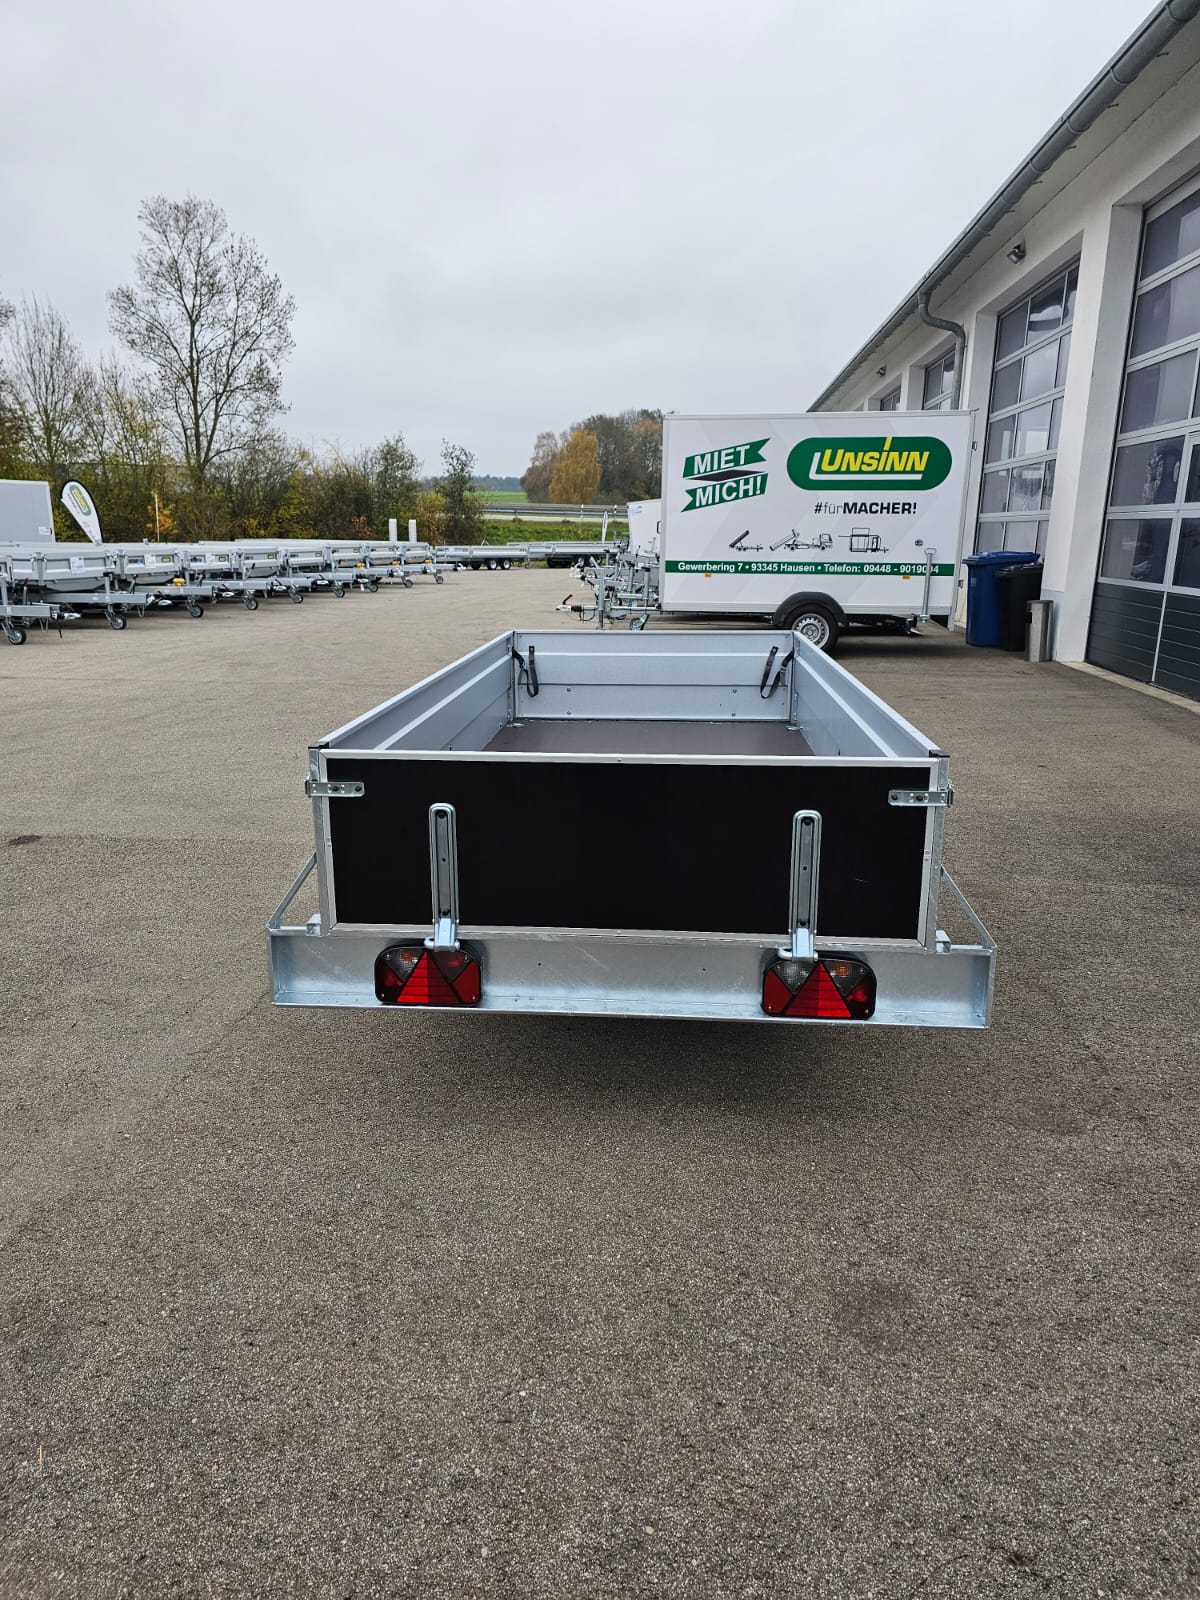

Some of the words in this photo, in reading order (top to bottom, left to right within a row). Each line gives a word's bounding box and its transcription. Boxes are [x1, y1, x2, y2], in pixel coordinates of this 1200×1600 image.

[694, 445, 750, 474] MIET
[695, 475, 762, 507] MICH!
[814, 501, 918, 515] #fürMACHER!
[678, 562, 735, 573] Gewerbering
[737, 563, 743, 572] 7
[751, 563, 778, 572] 93345
[780, 563, 815, 572] Hausen
[824, 564, 861, 573] Telefon:
[863, 564, 891, 573] 09448
